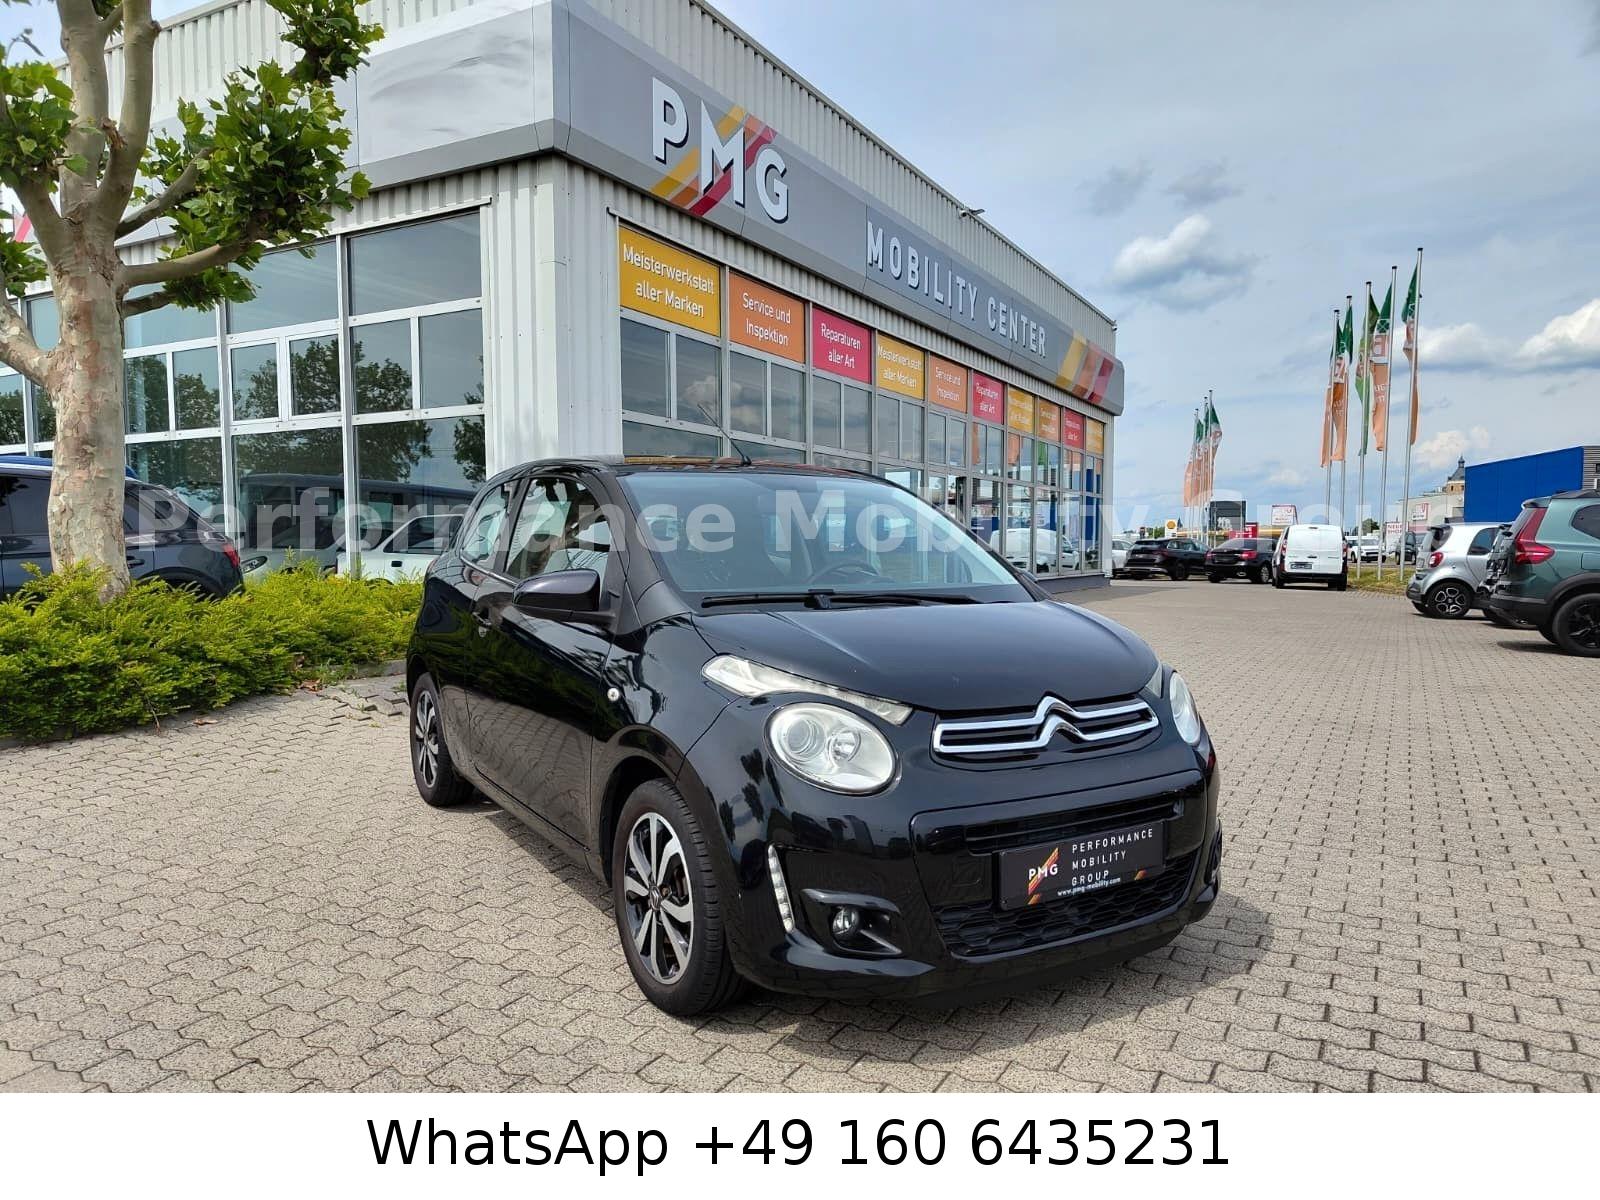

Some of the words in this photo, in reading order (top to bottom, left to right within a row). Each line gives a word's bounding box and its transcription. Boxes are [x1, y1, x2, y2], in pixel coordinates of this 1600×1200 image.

[653, 77, 788, 224] PMG
[623, 243, 714, 294] Meisterwerkstatt
[636, 281, 663, 303] aller
[665, 288, 705, 318] Marken
[868, 221, 978, 320] MOBILITY
[987, 296, 1046, 358] CENTER
[742, 292, 774, 318] Service
[775, 308, 791, 324] und
[746, 318, 789, 346] Inspektion
[820, 322, 861, 350] Reparaturen
[828, 349, 844, 364] aller
[845, 354, 855, 368] Art
[1071, 828, 1153, 853] PERFORMANCE
[1028, 863, 1058, 880] PMG
[1071, 850, 1127, 870] MOBILITY
[1057, 877, 1121, 896] www.pmg-mobility.com
[1071, 870, 1109, 886] GROUP
